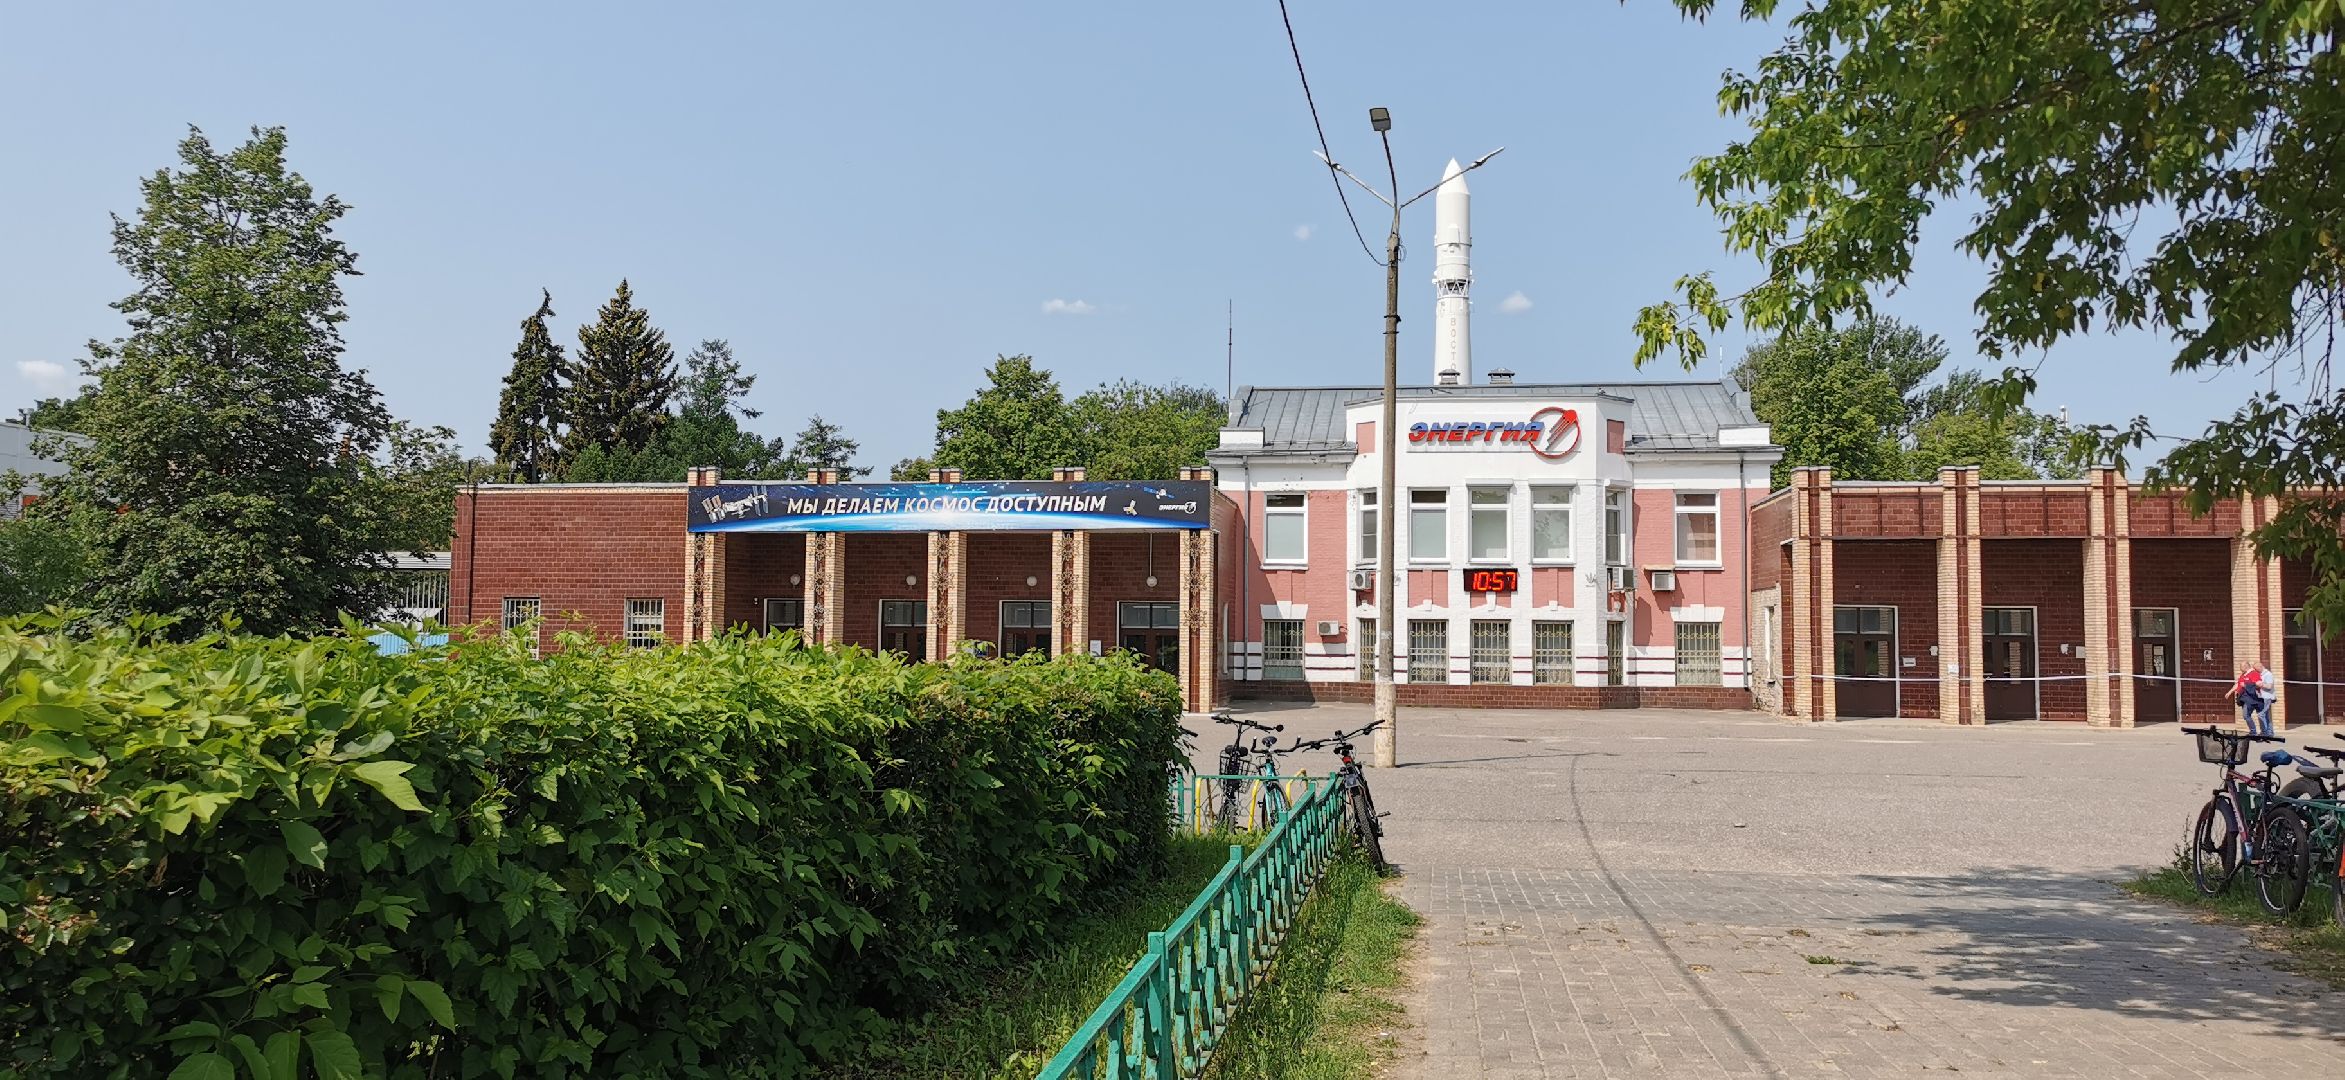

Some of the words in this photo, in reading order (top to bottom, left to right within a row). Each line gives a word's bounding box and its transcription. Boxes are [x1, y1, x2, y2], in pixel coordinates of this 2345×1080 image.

[1408, 421, 1545, 442] ЭНЕРГИЯ
[787, 498, 818, 514] МЫ
[822, 498, 899, 515] ДЕЛАЕМ
[904, 497, 982, 513] КОСМОС
[985, 495, 1107, 513] ДОСТУПНЫМ
[1473, 571, 1515, 590] 10:57
